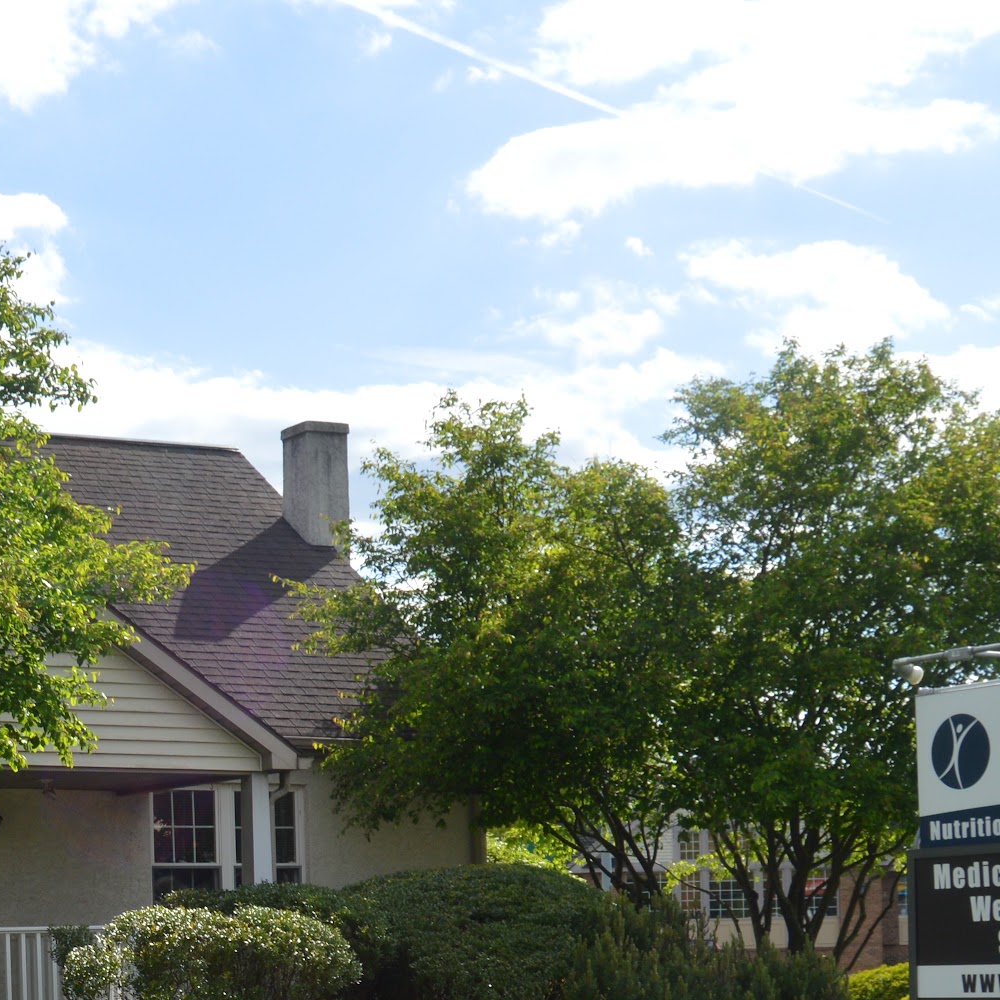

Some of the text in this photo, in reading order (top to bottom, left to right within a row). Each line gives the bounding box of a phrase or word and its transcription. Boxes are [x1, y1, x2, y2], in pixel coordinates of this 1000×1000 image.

[929, 816, 1000, 841] Nutritio
[933, 861, 1000, 890] Medic
[969, 895, 1000, 922] We
